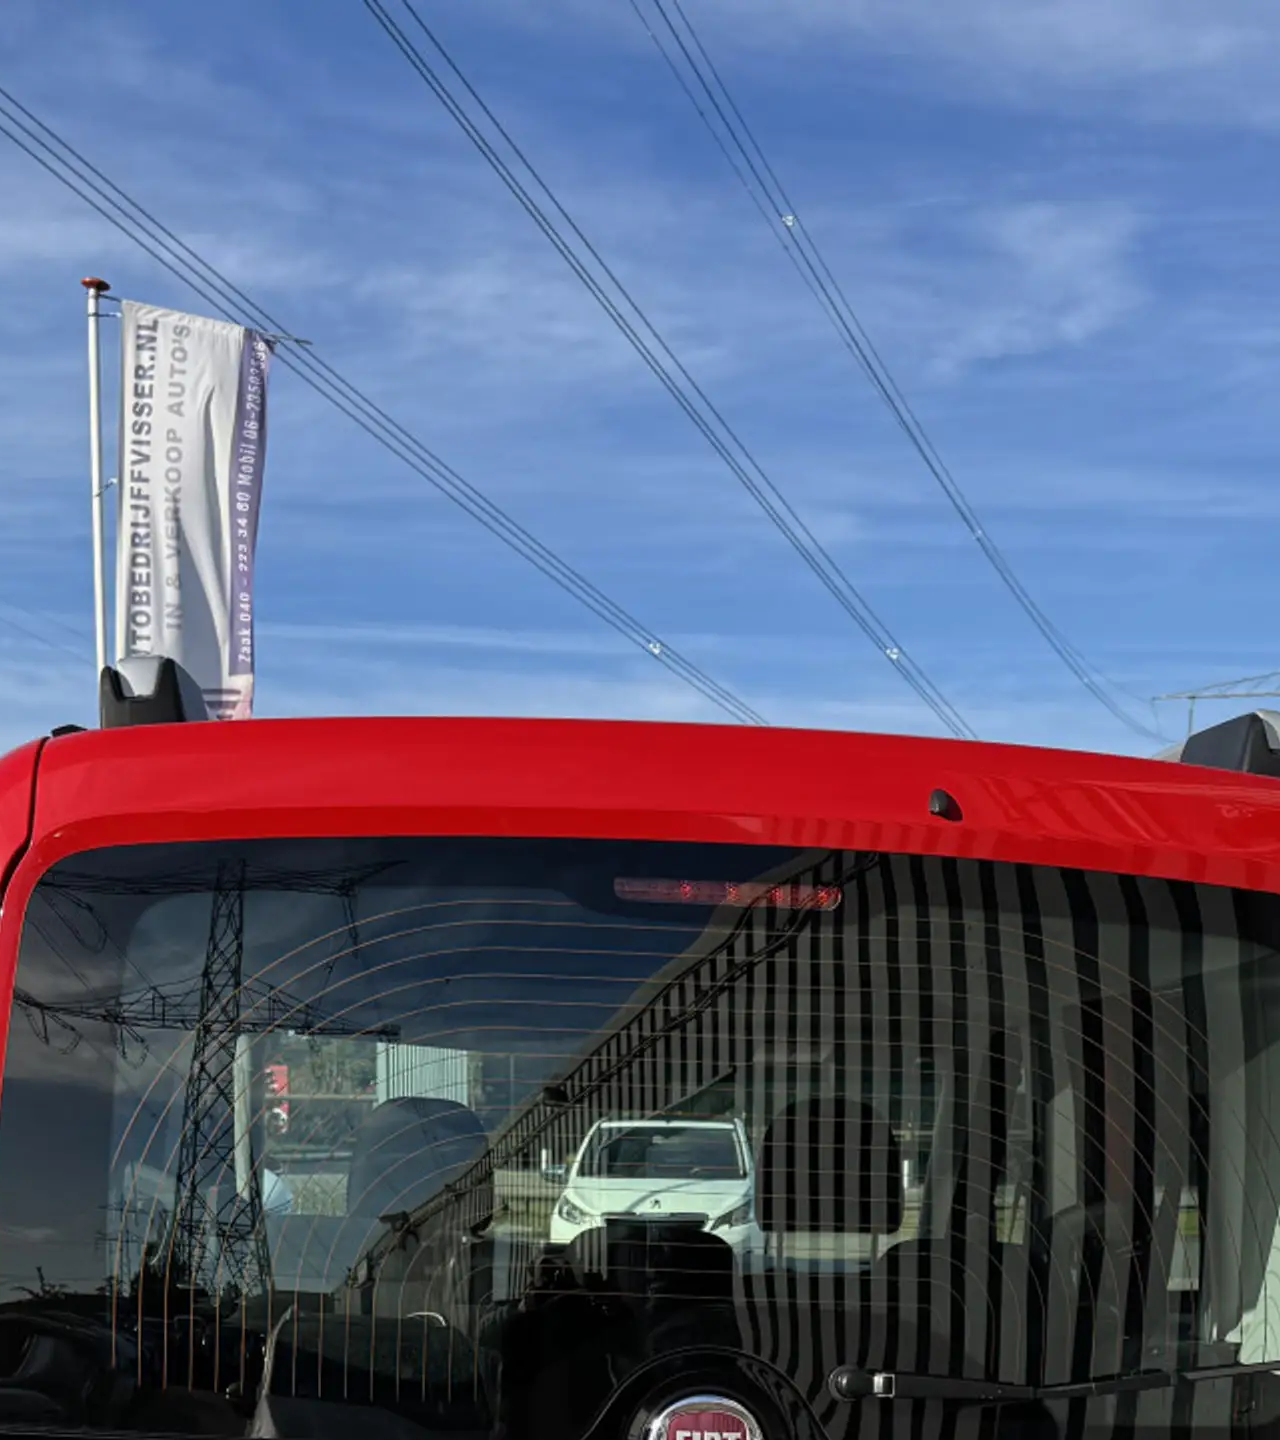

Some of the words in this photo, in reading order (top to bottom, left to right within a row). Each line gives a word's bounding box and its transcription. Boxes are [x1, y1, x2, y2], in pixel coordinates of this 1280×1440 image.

[166, 324, 191, 417] AUTO'S
[237, 442, 257, 486] Mobil
[130, 319, 159, 657] TOBEDRIJFFVISSER.NL
[164, 429, 183, 559] VERKOOP
[166, 576, 181, 590] &
[166, 605, 183, 631] IN
[240, 592, 251, 621] 040
[238, 628, 251, 663] Zaak
